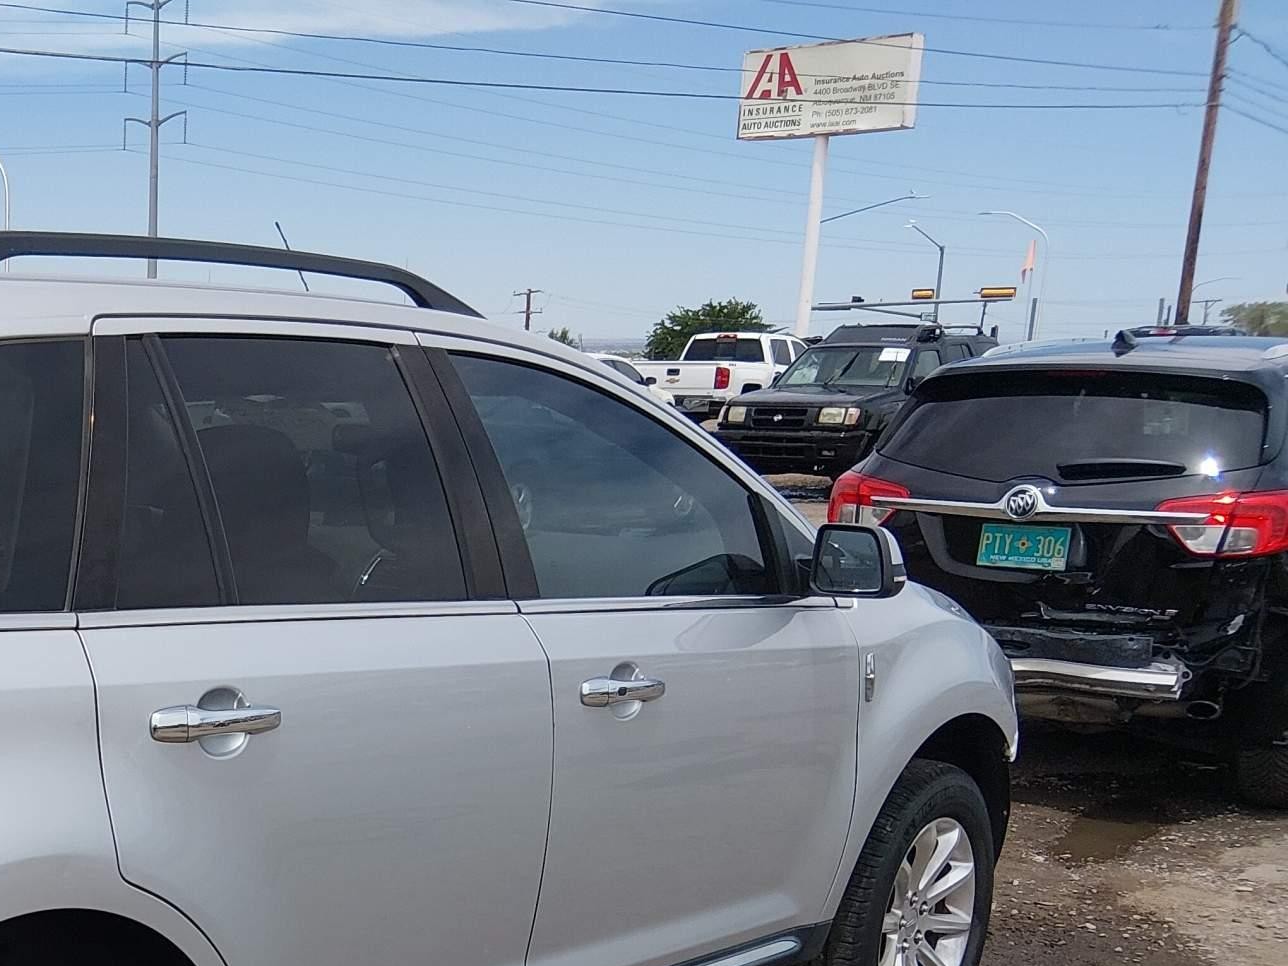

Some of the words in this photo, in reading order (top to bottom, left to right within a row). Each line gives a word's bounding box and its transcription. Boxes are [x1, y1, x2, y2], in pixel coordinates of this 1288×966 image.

[814, 77, 849, 86] Insurance
[871, 71, 905, 80] Auctions
[813, 87, 831, 95] 4400
[832, 84, 866, 94] Broadway
[867, 82, 888, 91] BLVD
[890, 80, 901, 88] SE
[859, 95, 873, 103] NM
[743, 104, 803, 117] INSURANCE
[825, 108, 843, 118] (505)
[742, 121, 762, 131] AUTO
[764, 119, 801, 130] AUCTIONS
[982, 532, 1014, 554] PTY
[1034, 535, 1065, 558] 306
[1008, 555, 1036, 563] MEXICO
